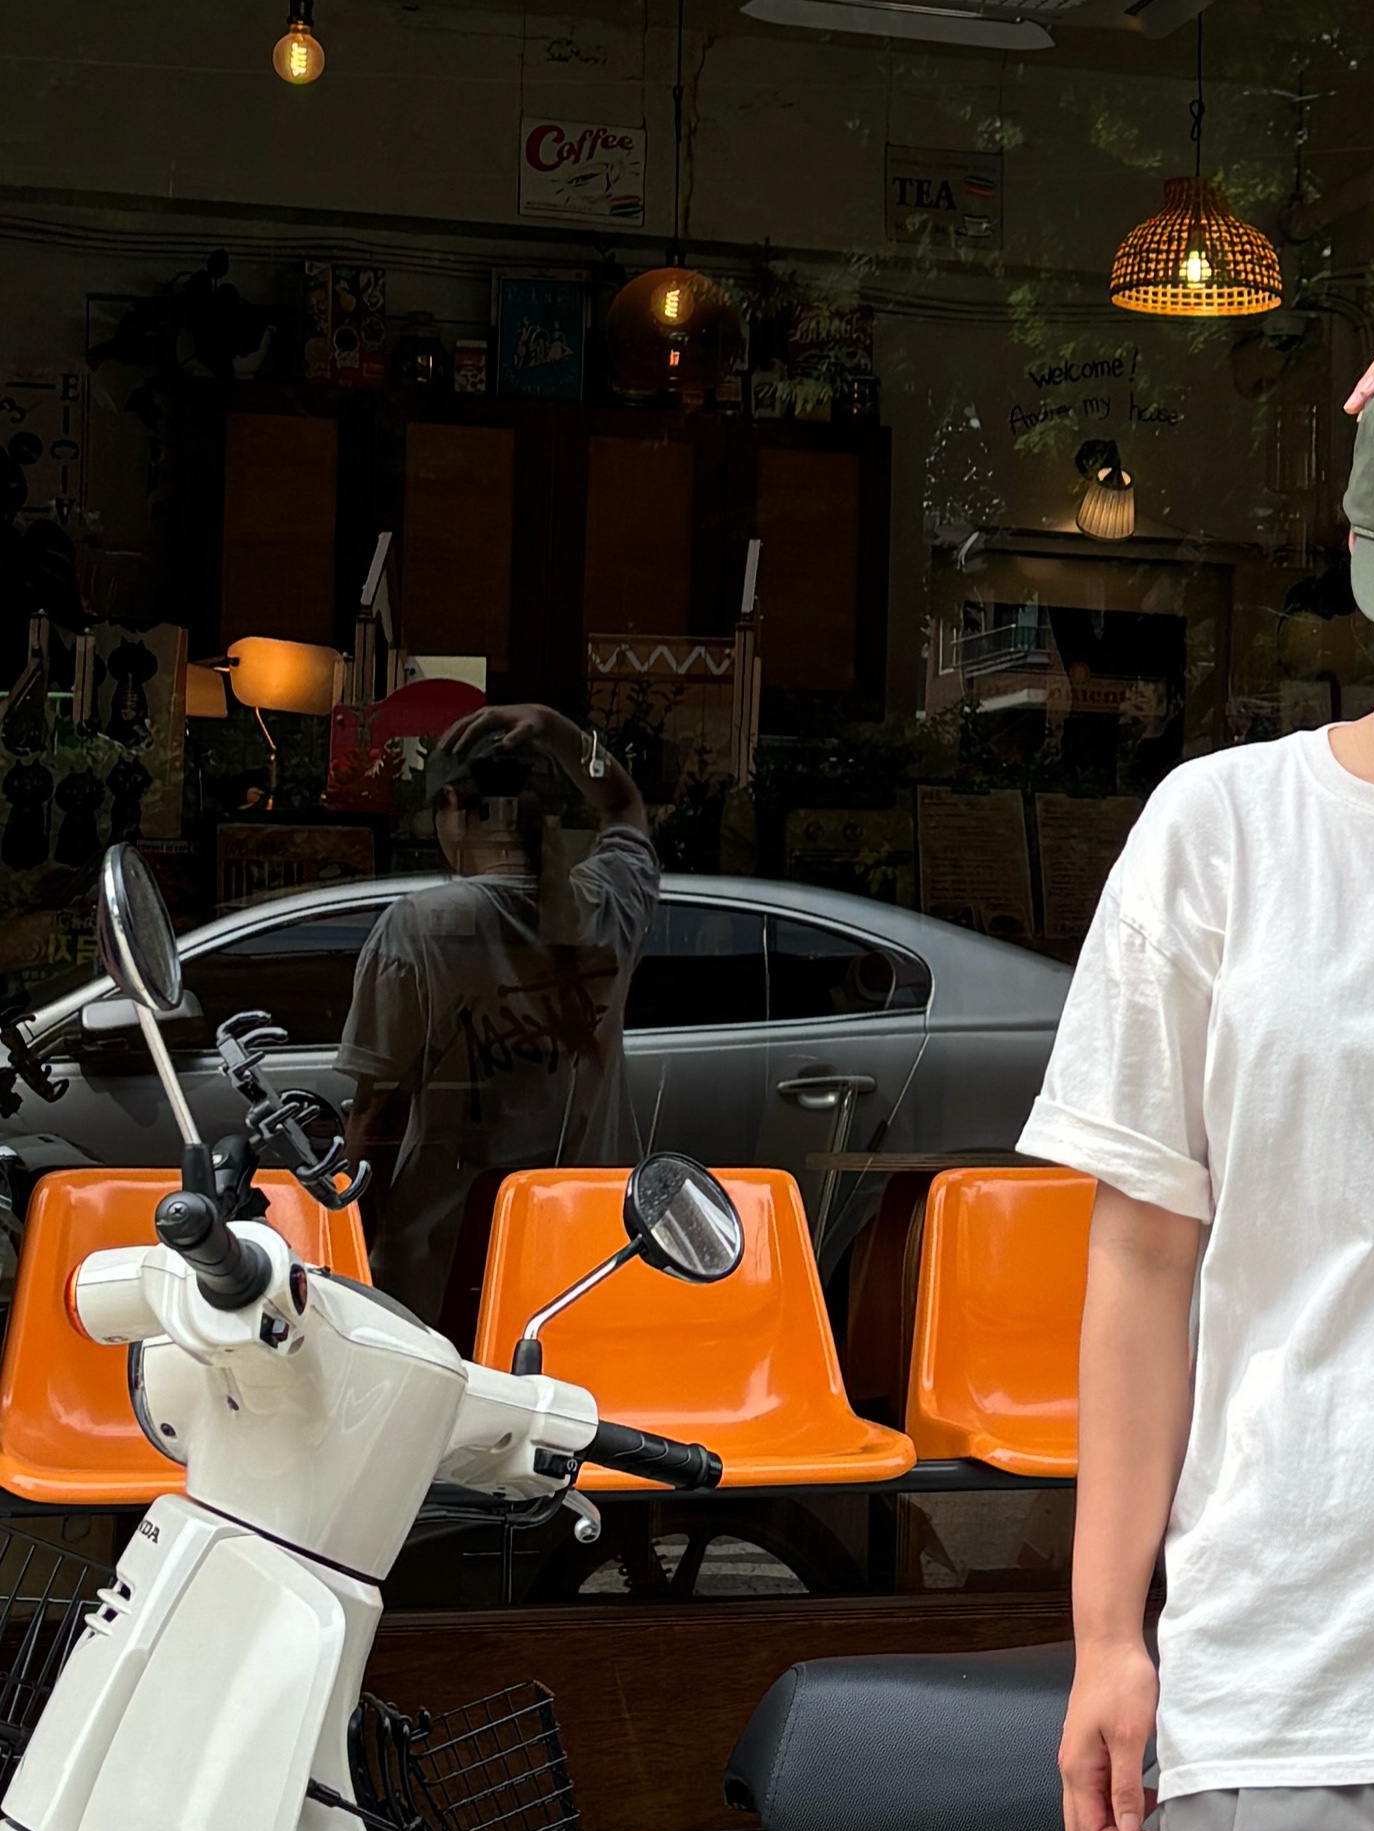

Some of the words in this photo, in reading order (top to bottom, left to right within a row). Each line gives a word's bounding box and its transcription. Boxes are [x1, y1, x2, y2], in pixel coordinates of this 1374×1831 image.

[526, 125, 634, 171] Coffee
[892, 177, 957, 210] TEA
[1083, 396, 1111, 421] my
